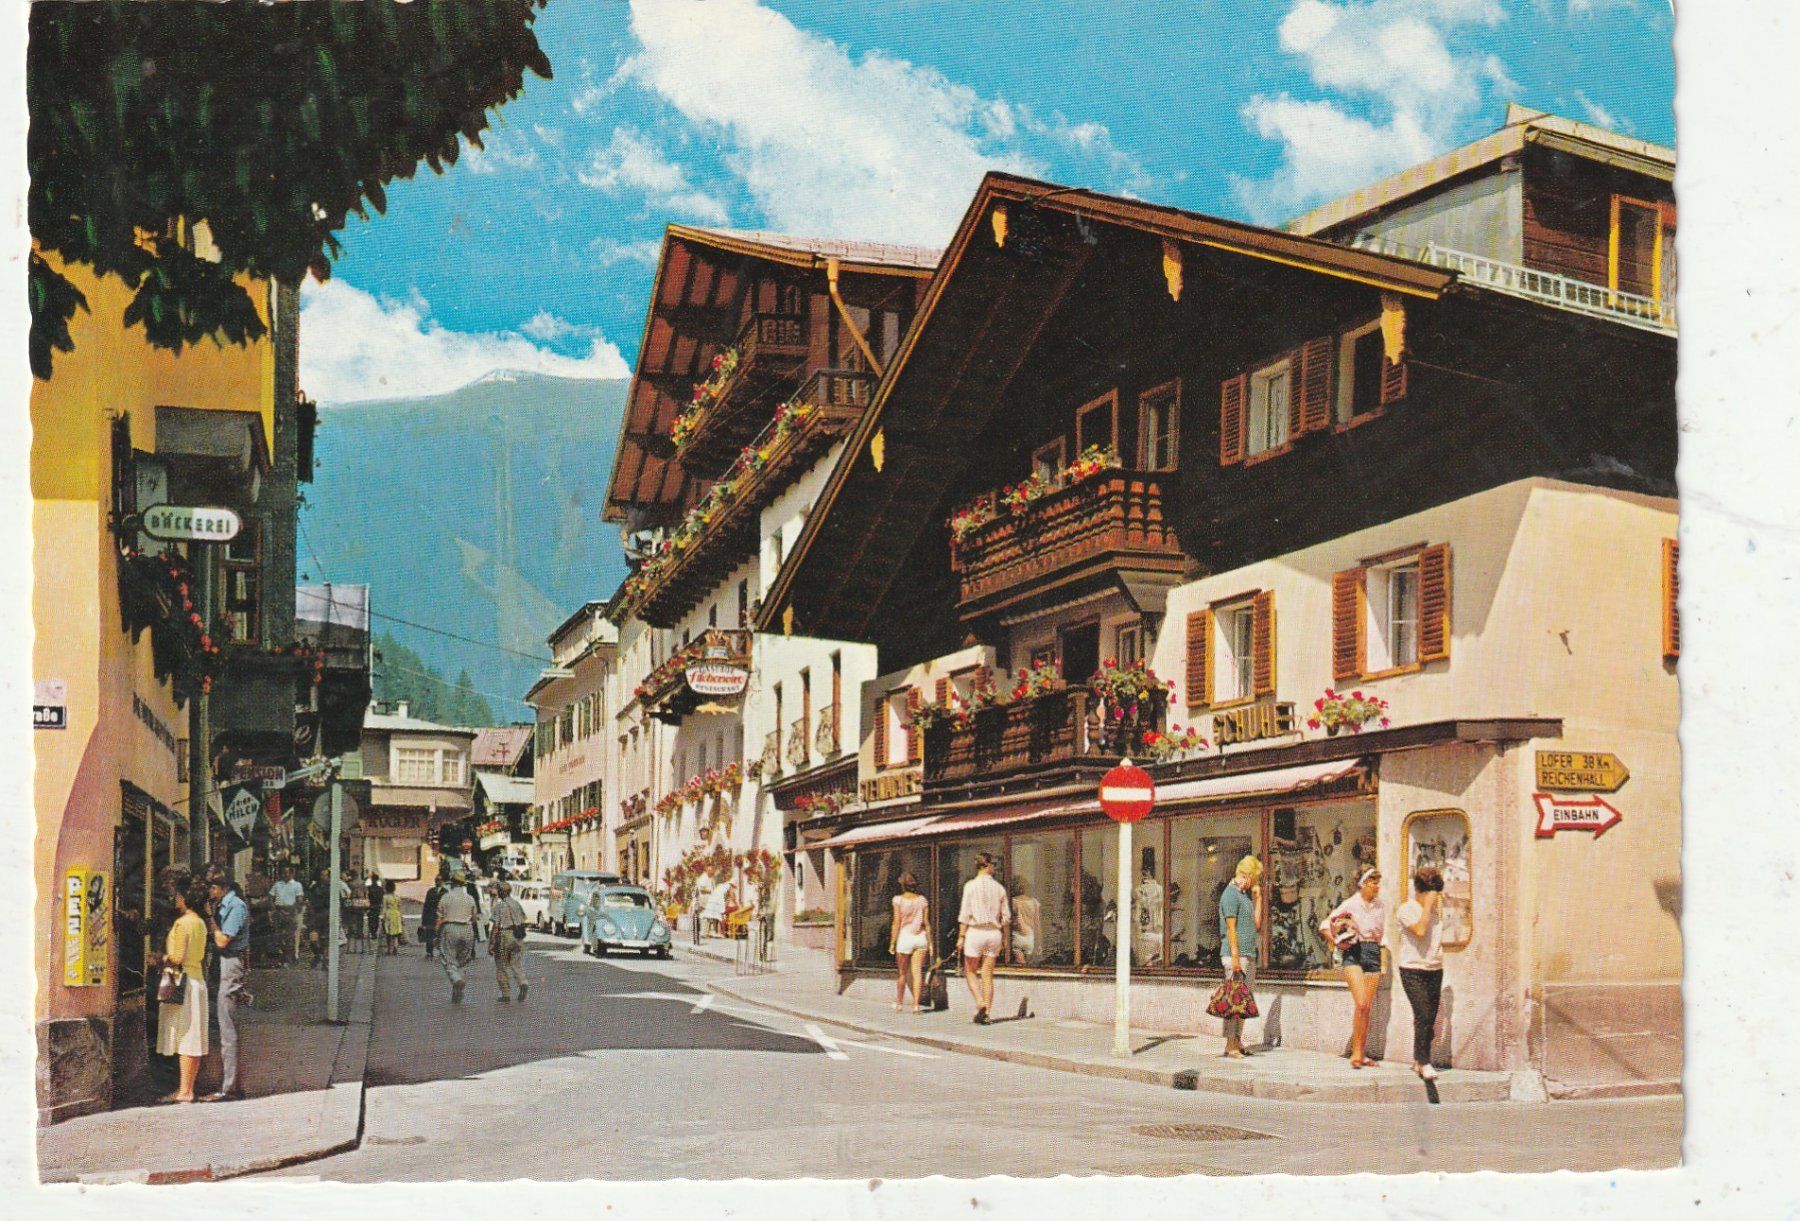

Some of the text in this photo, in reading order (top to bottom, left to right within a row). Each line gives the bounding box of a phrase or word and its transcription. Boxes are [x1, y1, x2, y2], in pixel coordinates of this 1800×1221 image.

[151, 512, 231, 534] BÄCKEREI
[1213, 702, 1296, 746] SCHUHE
[1541, 754, 1573, 768] LOFER
[1583, 755, 1595, 769] 38
[1541, 771, 1606, 787] REICHENHALL
[1553, 808, 1600, 821] EINBAHN
